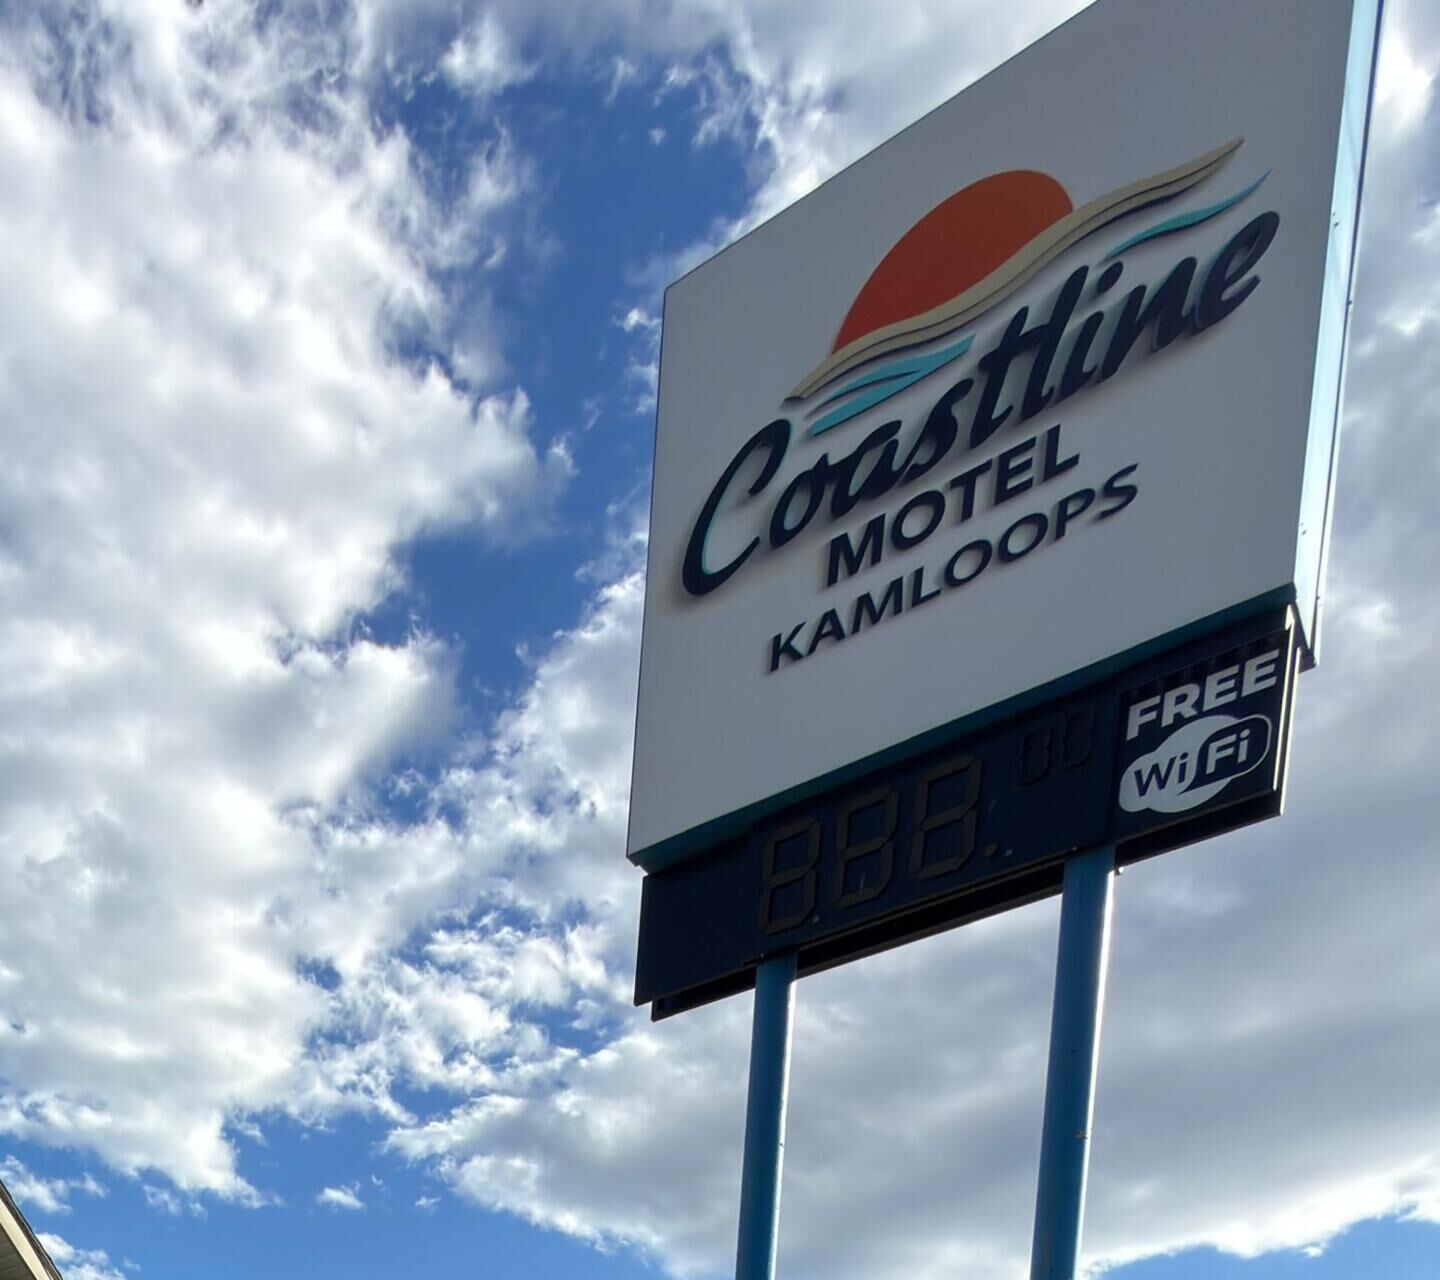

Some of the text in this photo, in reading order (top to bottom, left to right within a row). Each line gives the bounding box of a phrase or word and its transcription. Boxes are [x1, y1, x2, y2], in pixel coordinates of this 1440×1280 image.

[681, 210, 1280, 596] Coastline
[768, 463, 1139, 673] KAMLOOPS
[825, 424, 1081, 588] MOTEL
[1126, 649, 1280, 741] FREE
[1133, 728, 1251, 797] WiFi
